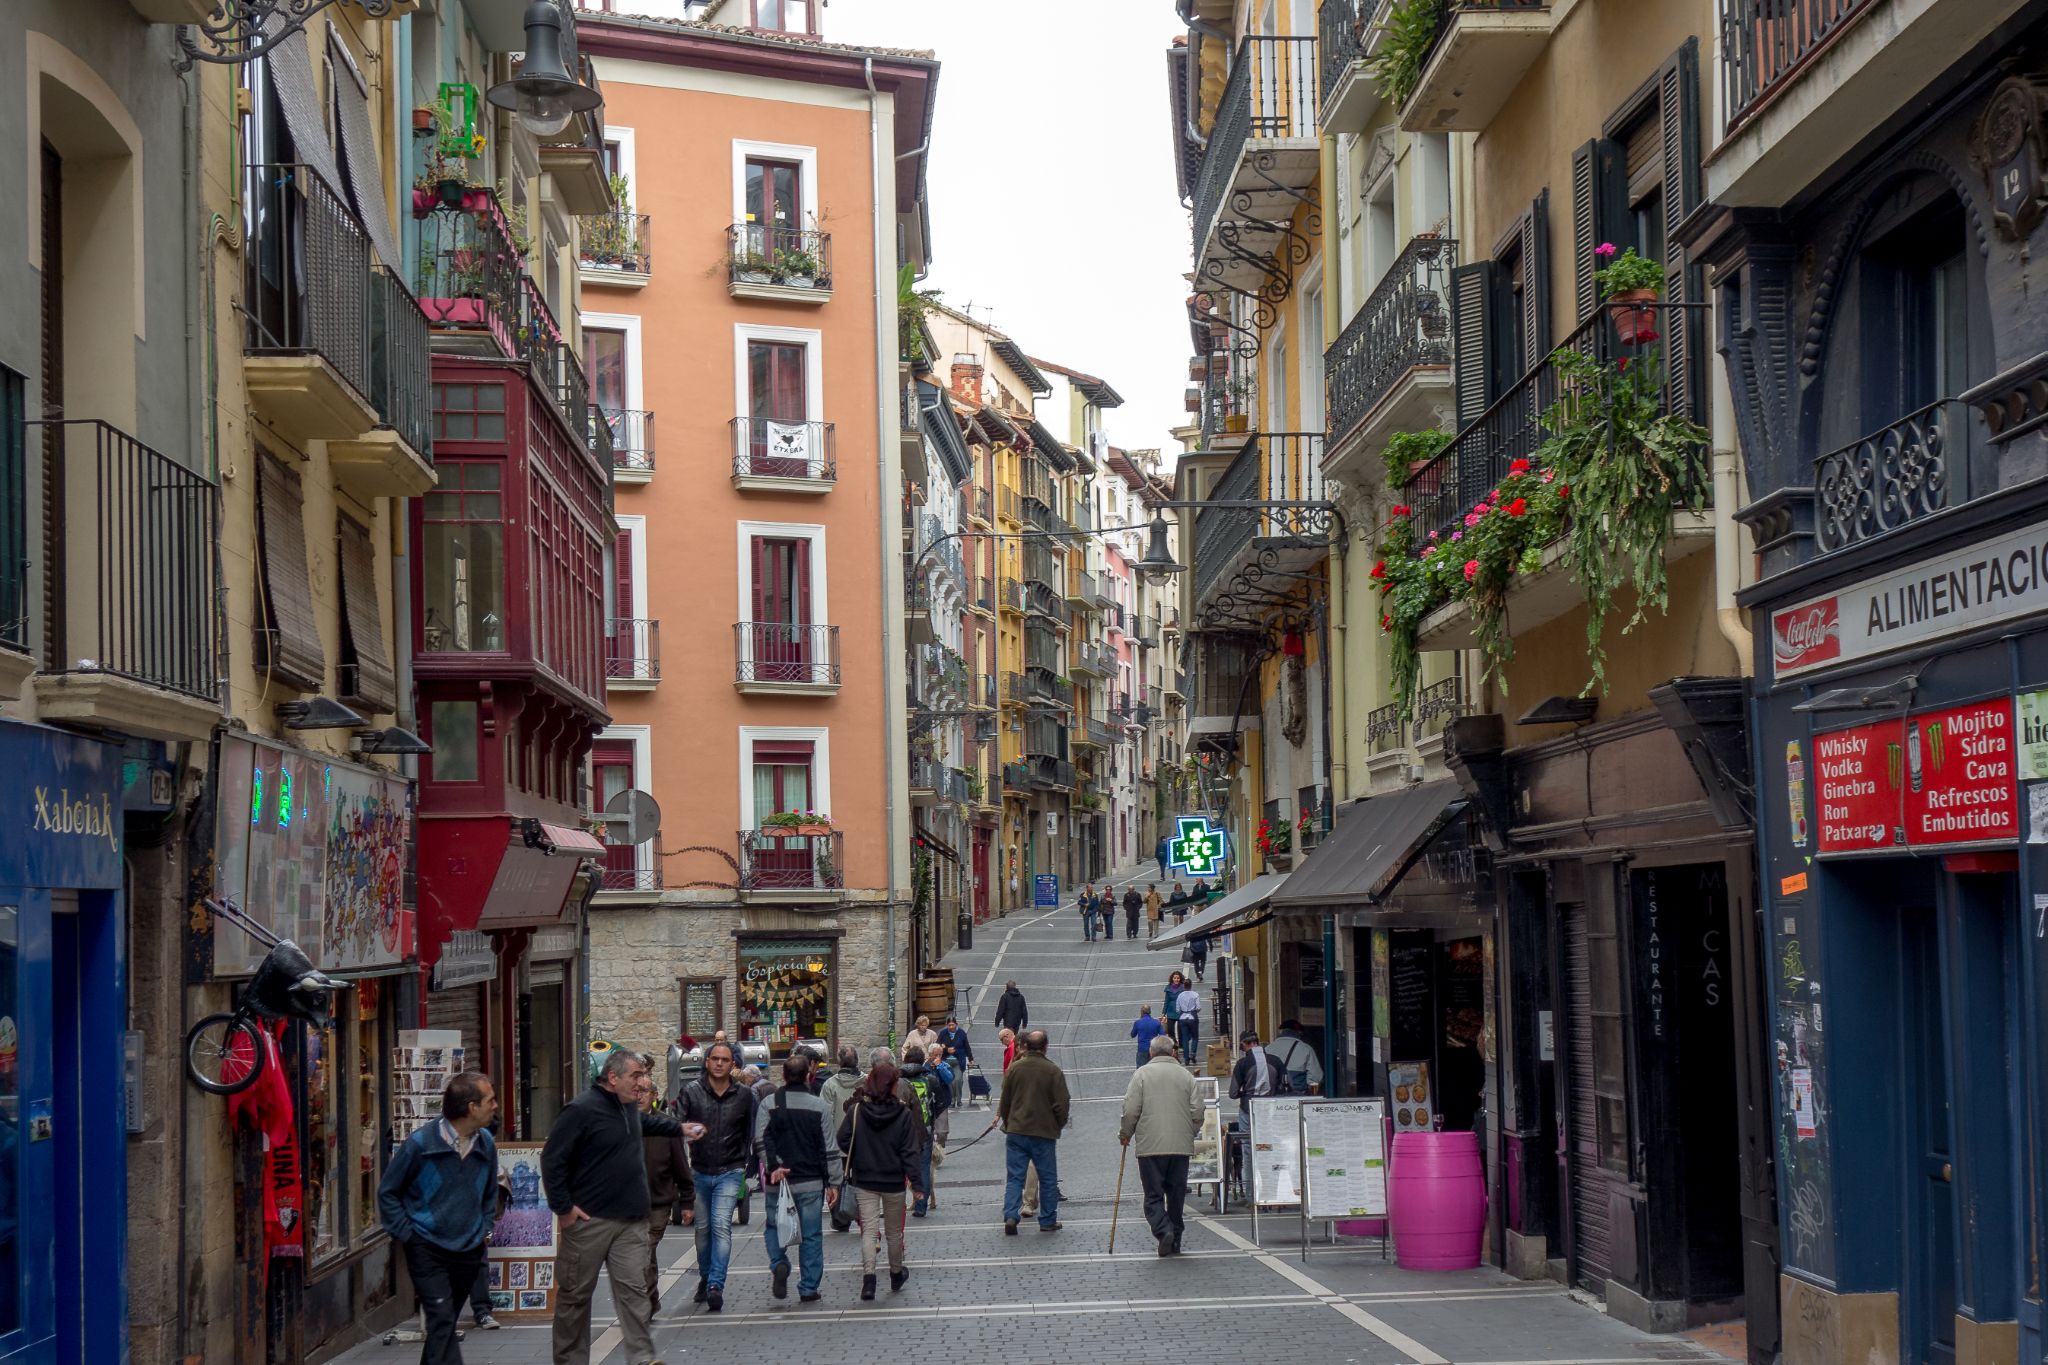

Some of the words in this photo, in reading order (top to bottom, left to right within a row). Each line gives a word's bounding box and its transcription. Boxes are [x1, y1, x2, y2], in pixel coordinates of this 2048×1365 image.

[1948, 710, 2004, 736] Mojito
[1820, 735, 1868, 758] Whisky
[1961, 736, 2006, 757] Sidra
[1821, 758, 1863, 779] Vodka
[1966, 760, 2007, 781] Cava
[1823, 778, 1876, 800] Ginebra
[1928, 786, 2008, 809] Refrescos
[1824, 804, 1848, 821] Ron
[1922, 809, 2009, 833] Embutidos
[1647, 870, 1662, 1036] RESTAURANTE
[498, 1149, 522, 1157] POSTERS
